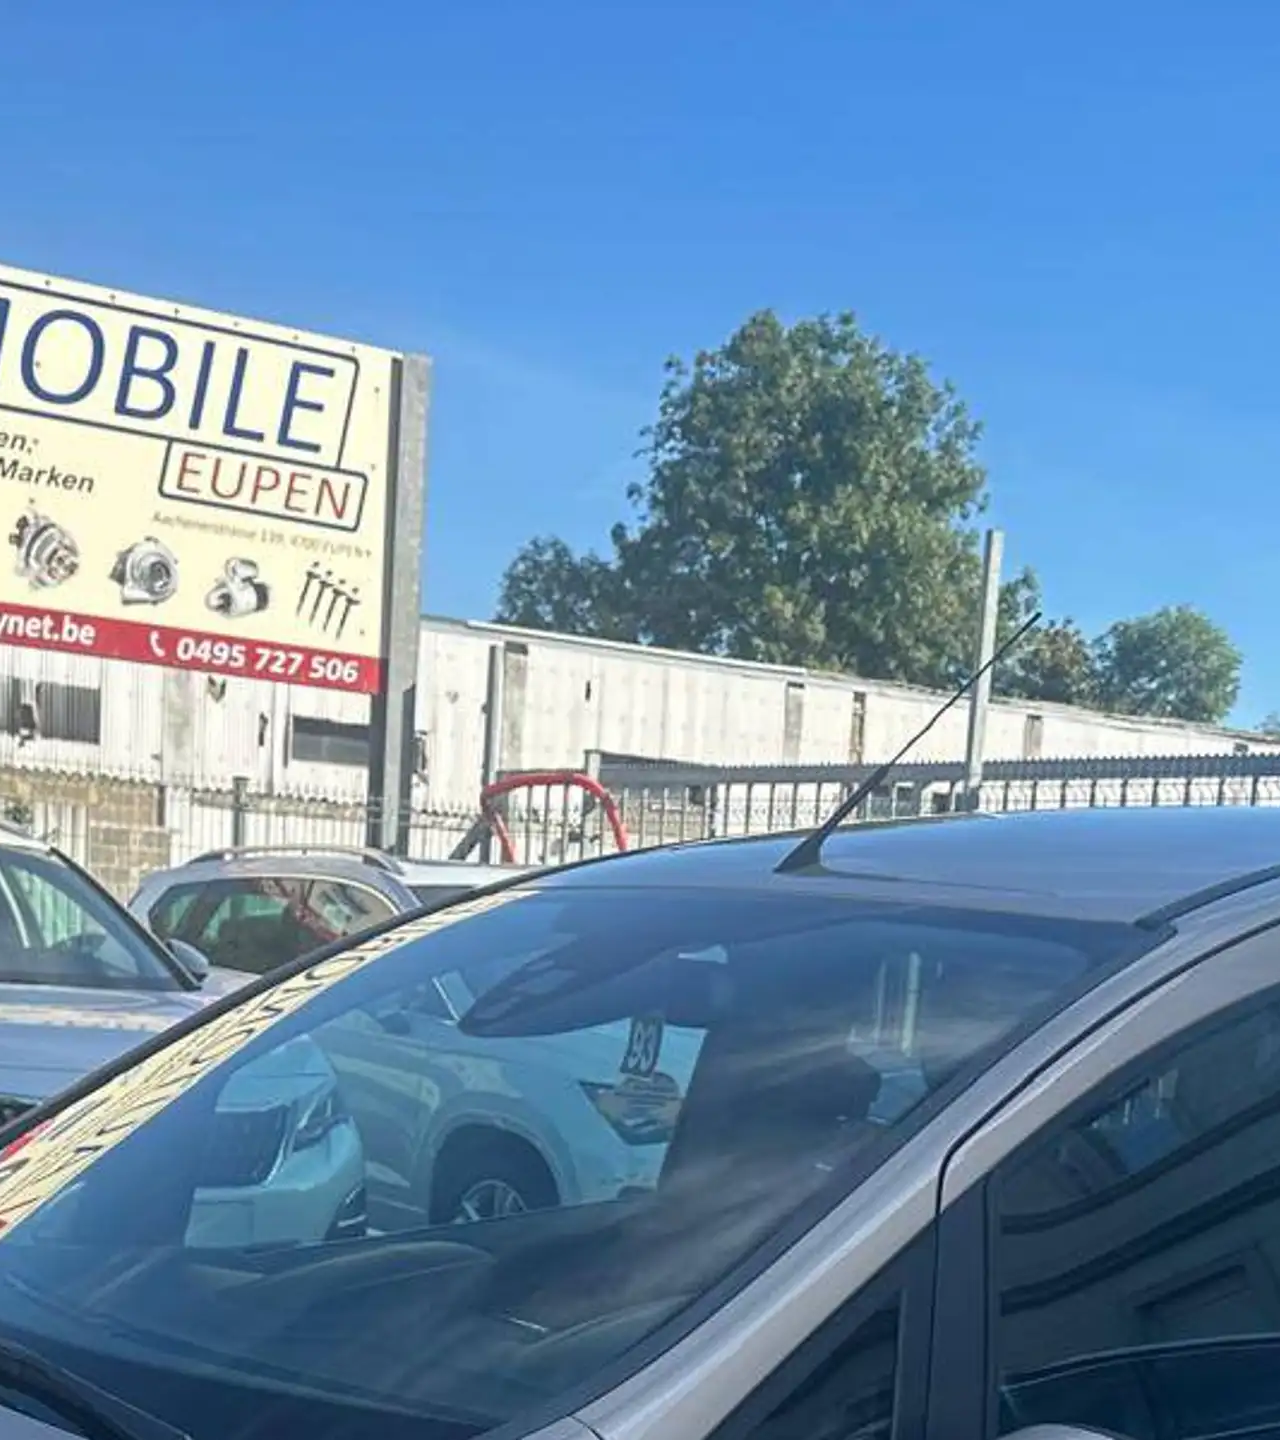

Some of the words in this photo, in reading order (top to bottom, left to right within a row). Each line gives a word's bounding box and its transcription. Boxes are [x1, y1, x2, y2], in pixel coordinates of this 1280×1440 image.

[176, 452, 352, 520] EUPEN
[176, 637, 247, 668] 0495
[252, 645, 306, 676] 727
[310, 651, 360, 683] 506
